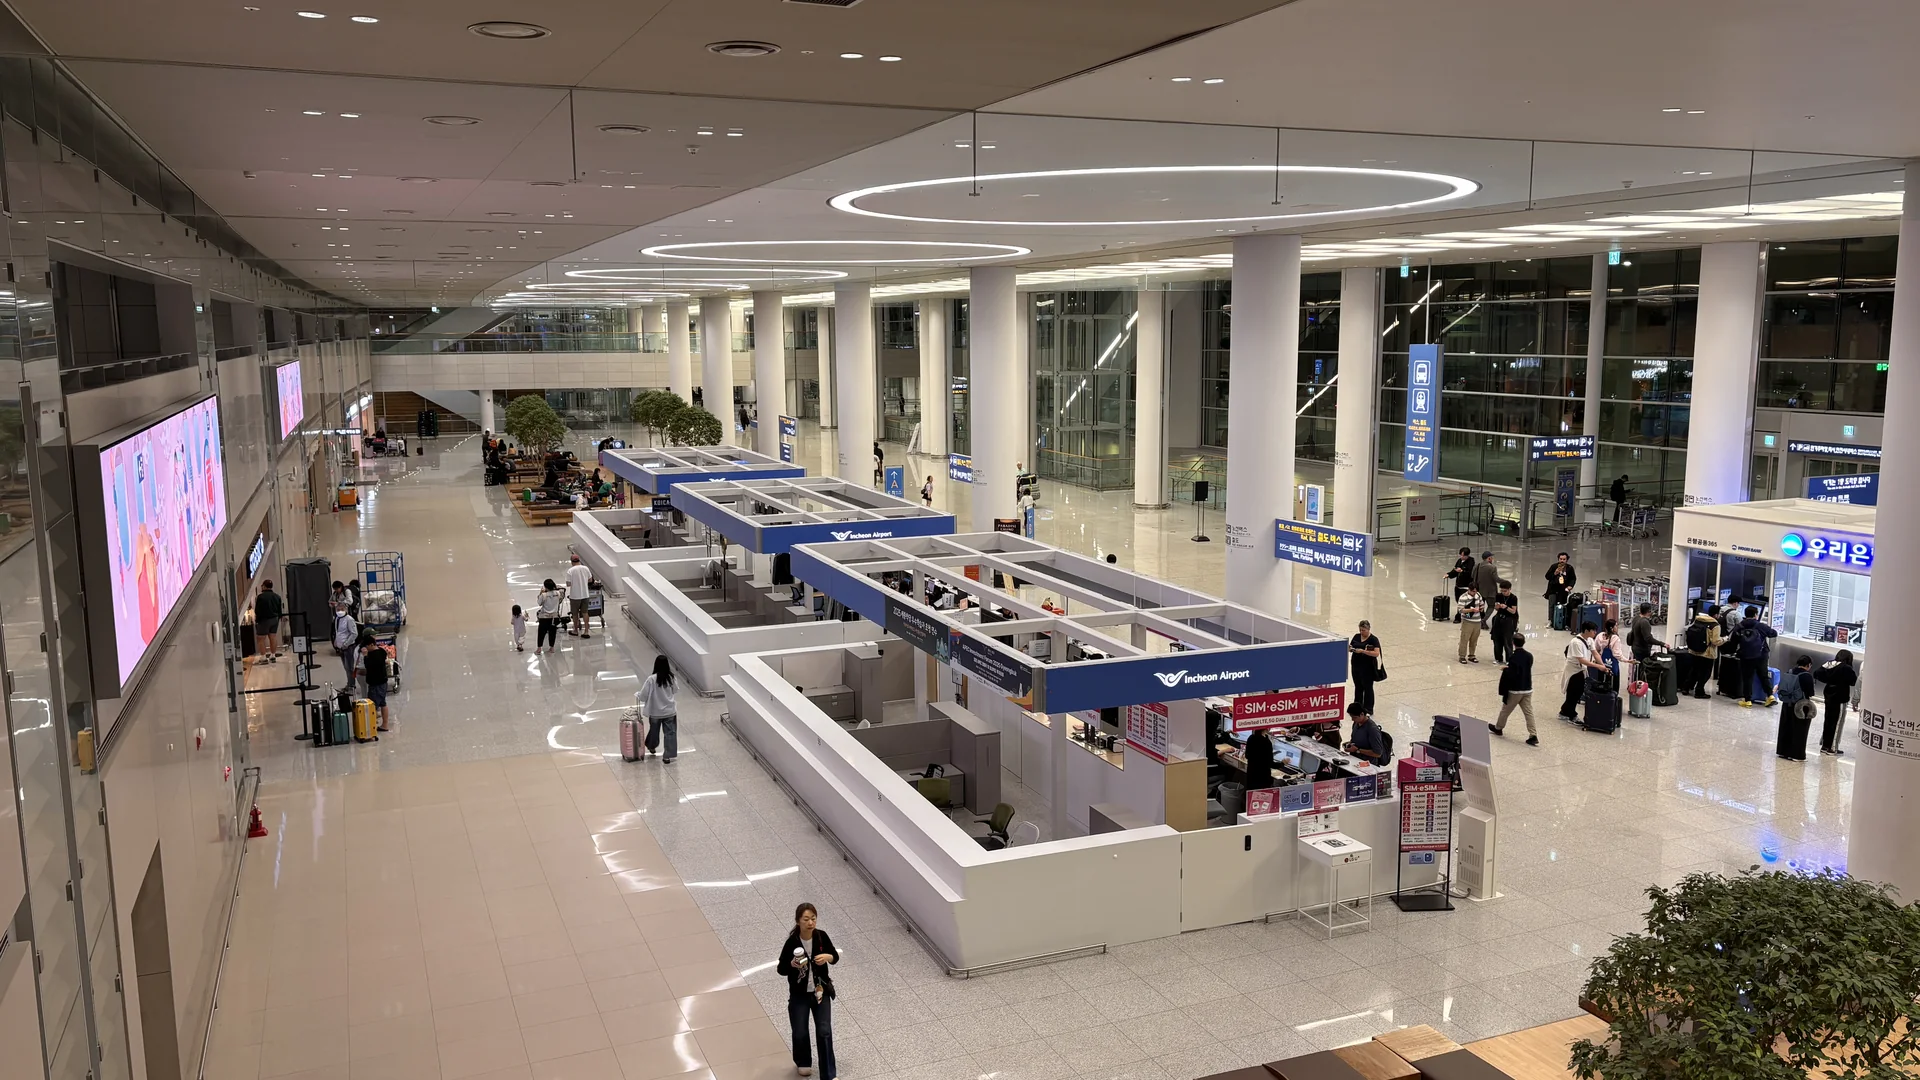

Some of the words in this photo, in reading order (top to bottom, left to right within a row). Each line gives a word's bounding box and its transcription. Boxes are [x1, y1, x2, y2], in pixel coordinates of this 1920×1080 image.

[1317, 532, 1342, 545] 철도,버스
[1807, 538, 1874, 566] 우리은
[1314, 552, 1341, 566] 택시,주차장
[1184, 672, 1218, 684] Incheon
[1220, 669, 1250, 683] Airport
[1309, 694, 1338, 707] Wi-Fi
[1887, 738, 1904, 749] 철도
